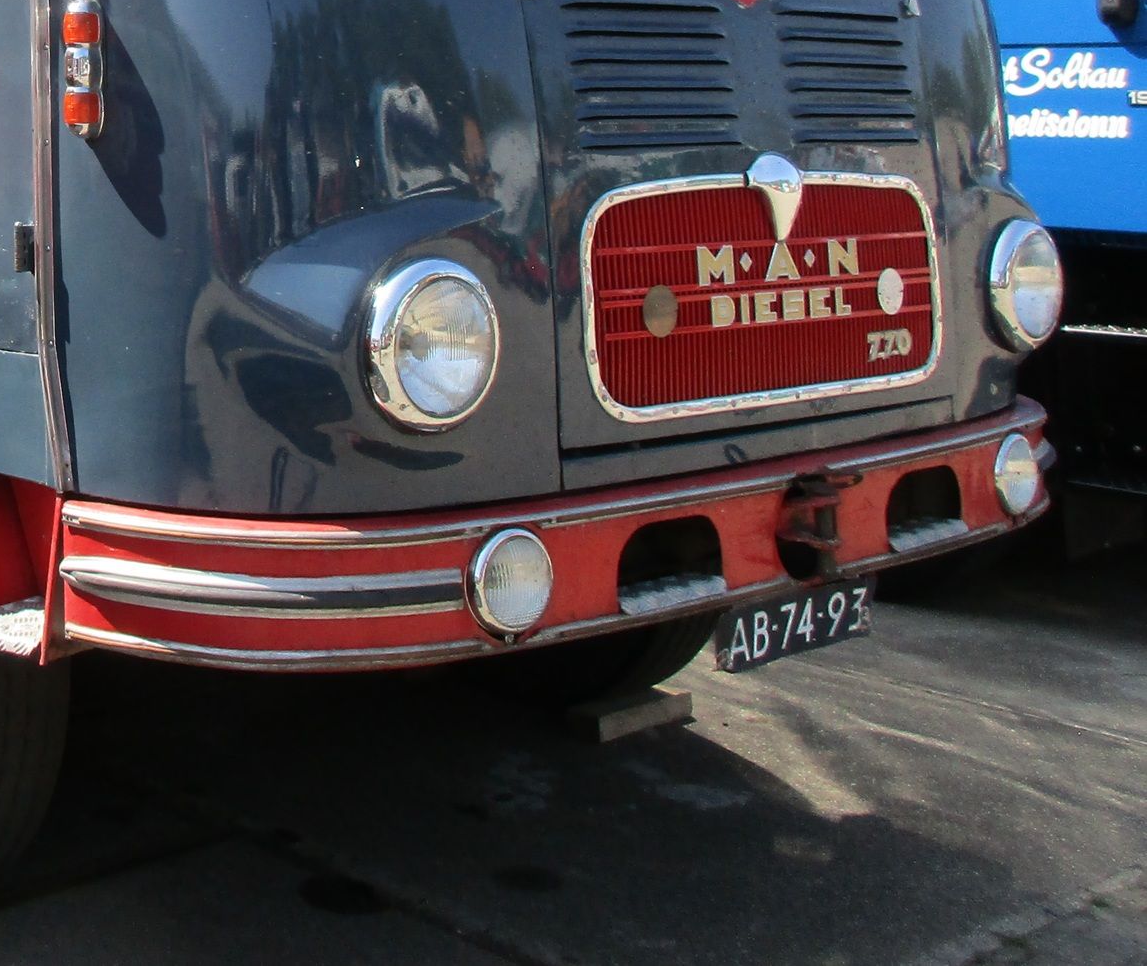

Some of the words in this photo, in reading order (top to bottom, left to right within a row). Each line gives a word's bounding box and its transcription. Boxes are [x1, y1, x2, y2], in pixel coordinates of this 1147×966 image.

[1005, 47, 1128, 96] Soltau
[711, 286, 853, 328] DIESEL
[867, 328, 913, 362] 770
